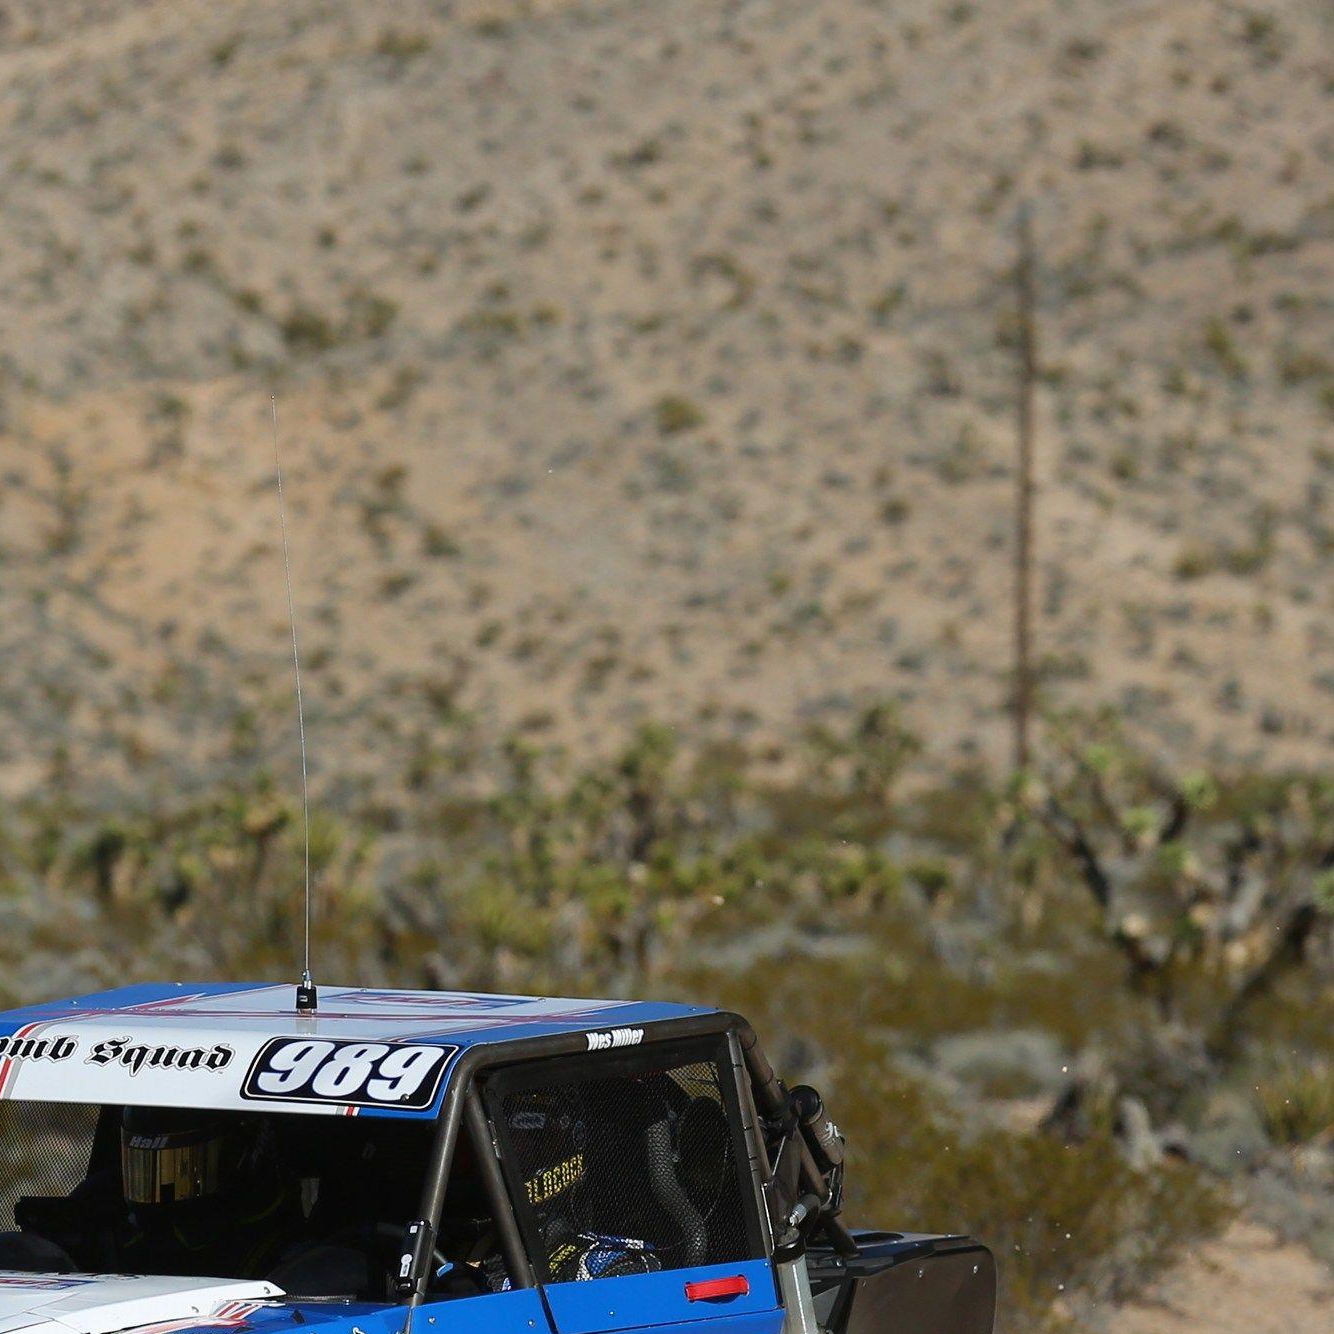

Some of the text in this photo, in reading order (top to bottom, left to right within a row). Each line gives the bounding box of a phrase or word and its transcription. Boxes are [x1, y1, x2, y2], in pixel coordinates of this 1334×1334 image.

[85, 1036, 236, 1077] Squad
[586, 1028, 644, 1050] Wes Miller
[258, 1041, 444, 1100] 989
